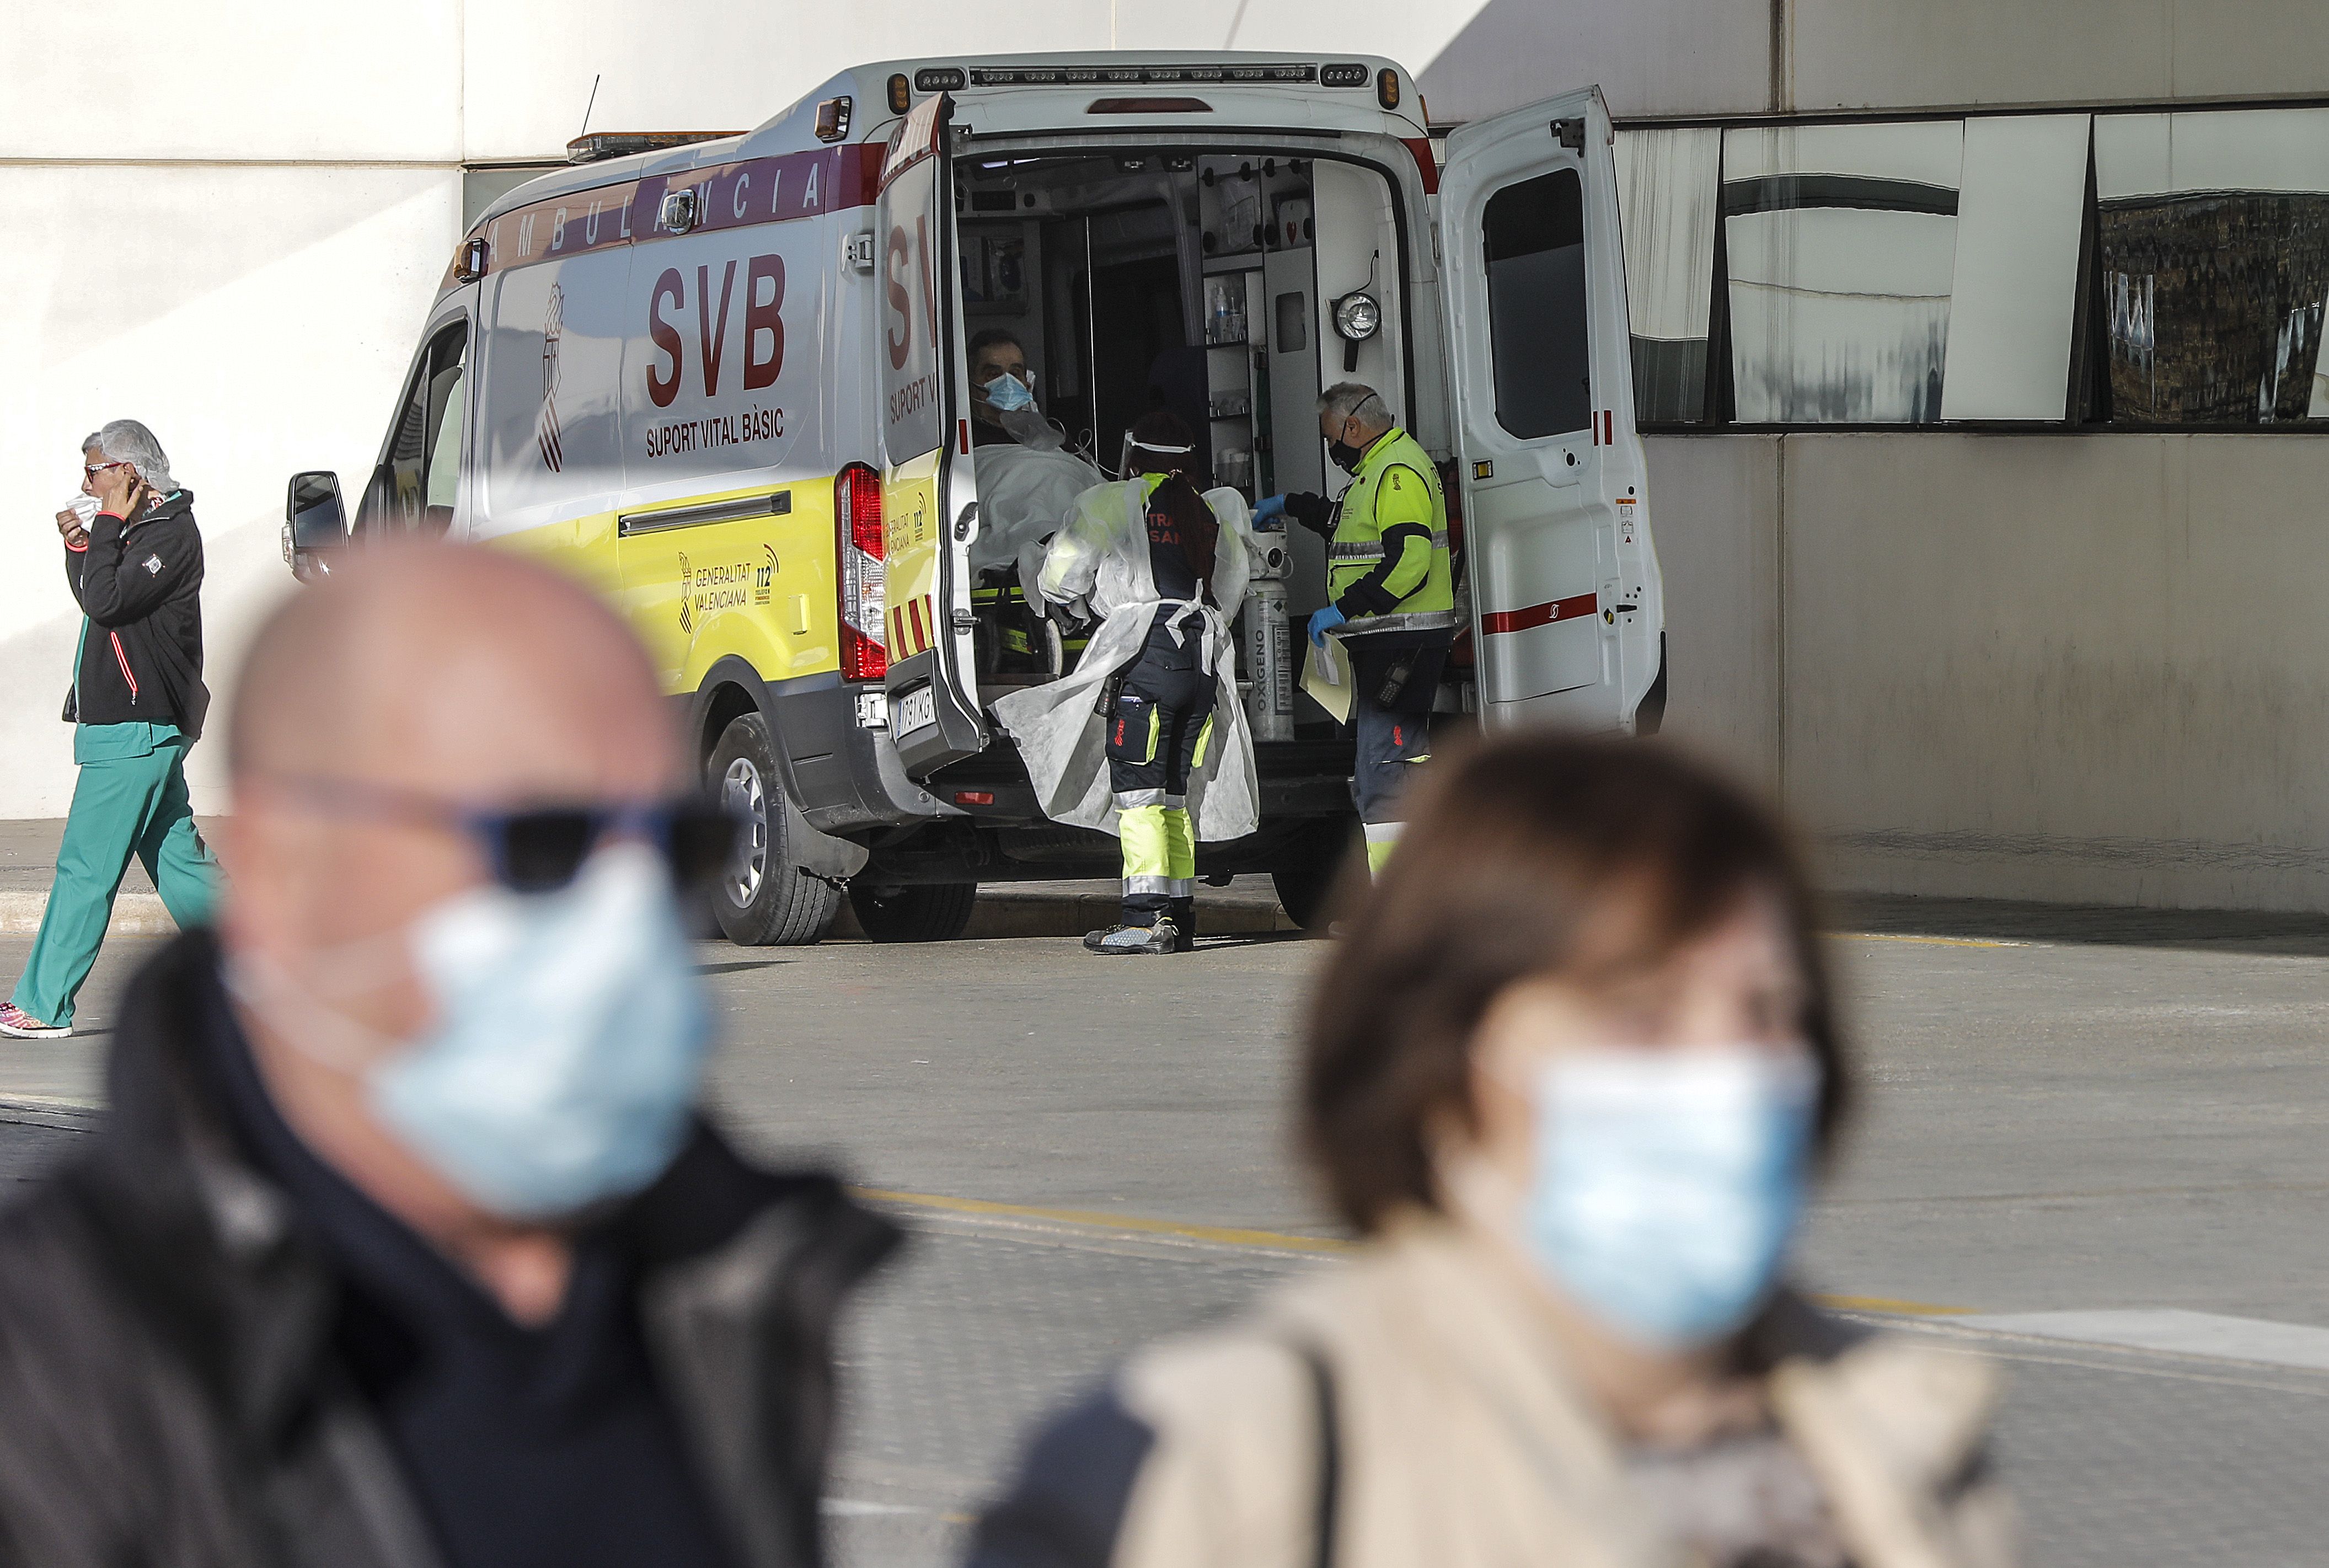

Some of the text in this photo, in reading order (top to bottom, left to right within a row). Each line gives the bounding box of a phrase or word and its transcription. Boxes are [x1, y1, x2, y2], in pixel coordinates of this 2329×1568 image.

[646, 253, 785, 408] SVB
[890, 377, 925, 425] SUPORT
[647, 404, 784, 458] SUPORT VITAL BÀSIC
[695, 563, 751, 587] GENERALITAT
[756, 565, 770, 588] 112
[694, 588, 746, 612] VALENCIANA
